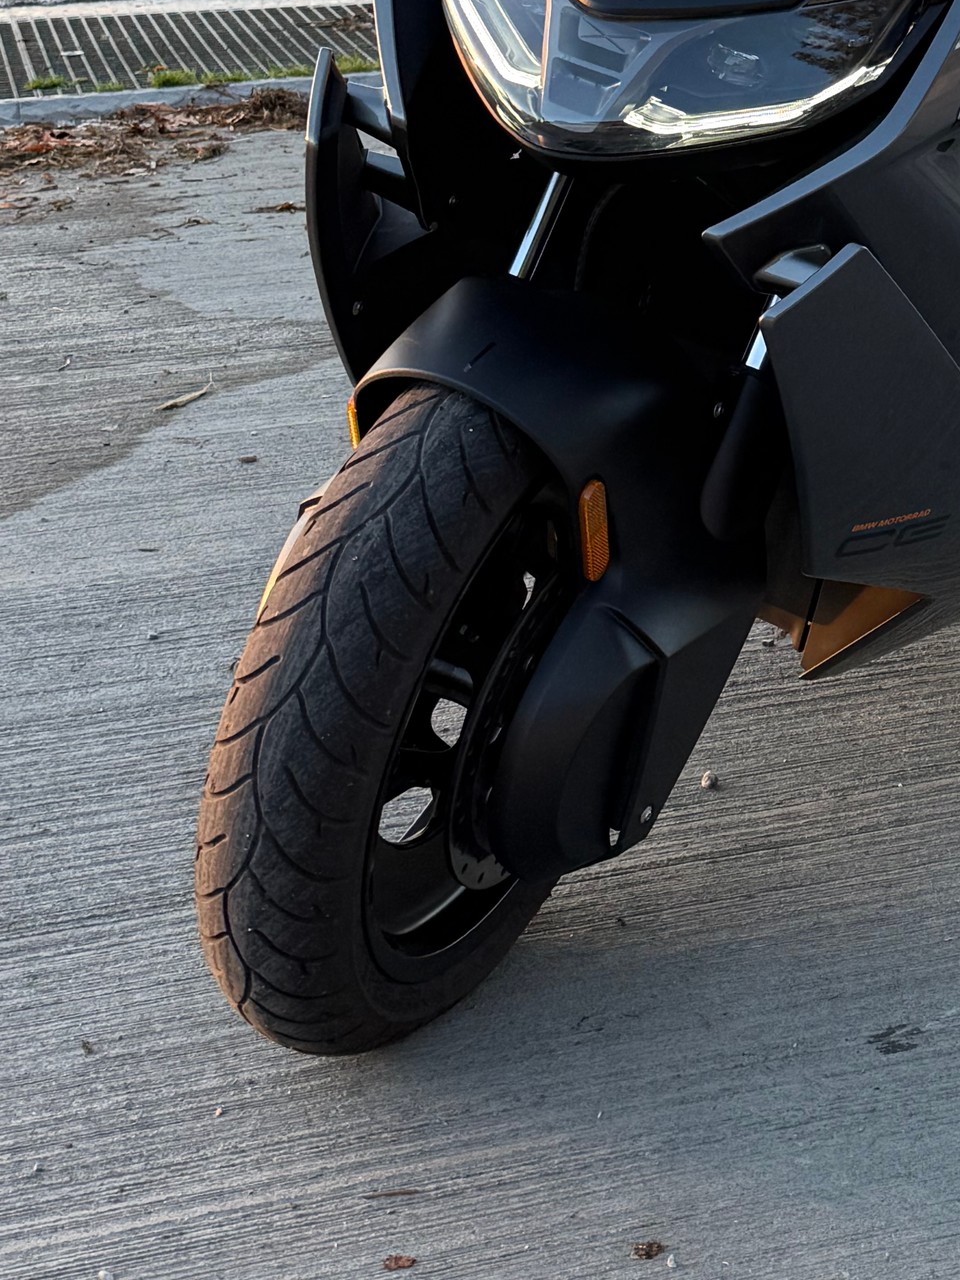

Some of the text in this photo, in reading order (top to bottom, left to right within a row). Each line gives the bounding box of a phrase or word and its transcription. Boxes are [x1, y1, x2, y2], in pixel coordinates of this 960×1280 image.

[835, 514, 951, 558] CE
[851, 508, 932, 533] BMW MOTORRAD
